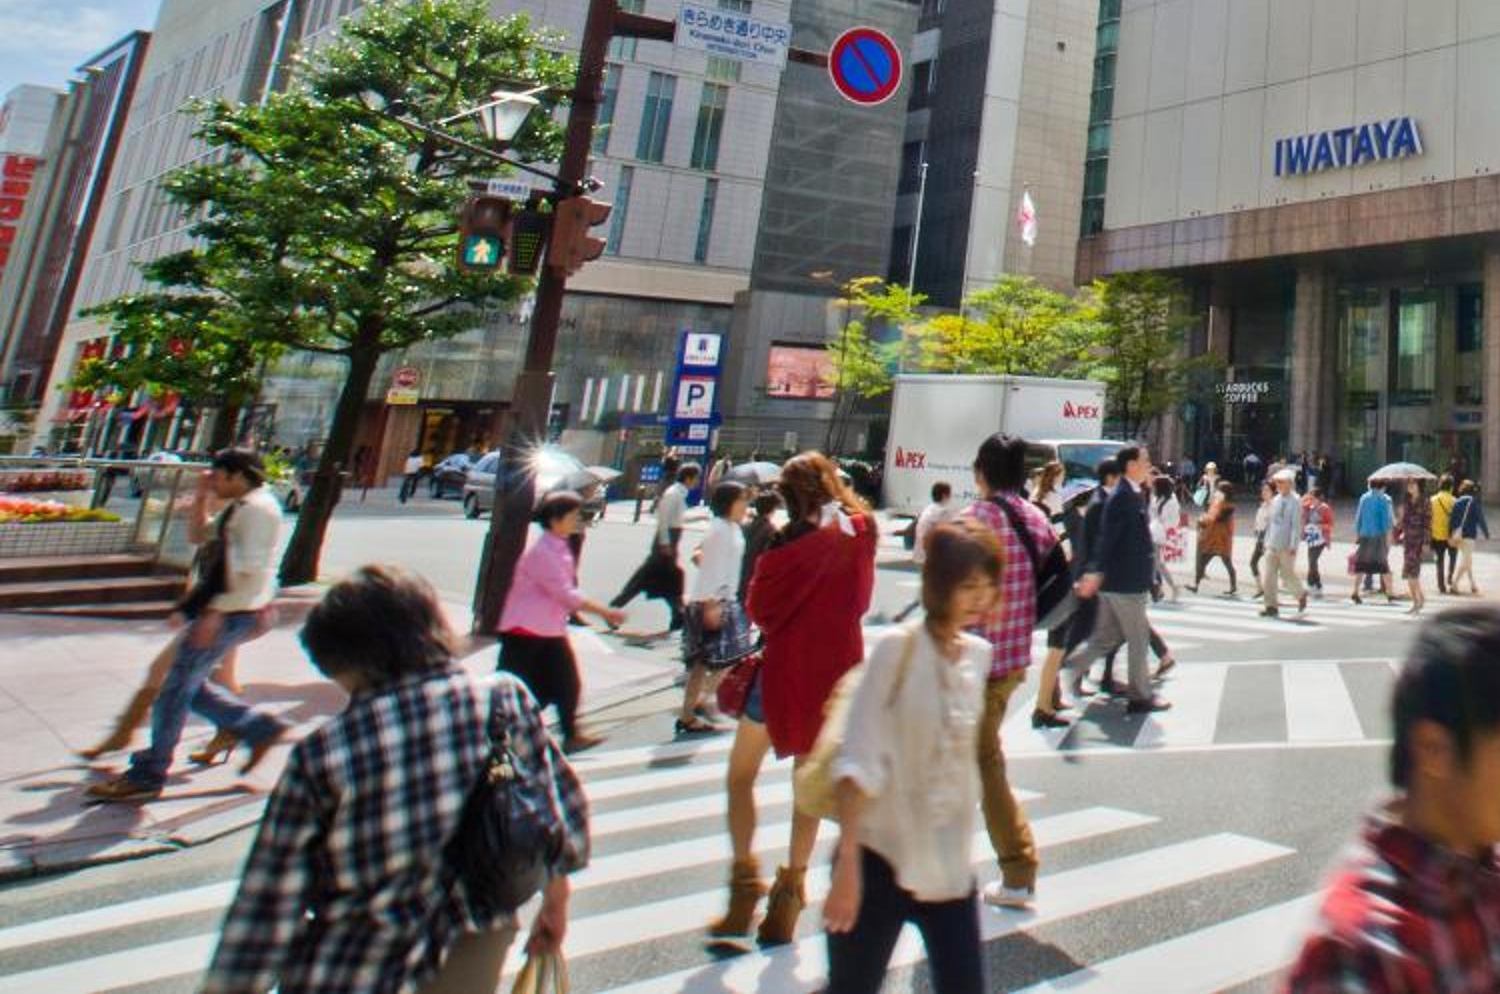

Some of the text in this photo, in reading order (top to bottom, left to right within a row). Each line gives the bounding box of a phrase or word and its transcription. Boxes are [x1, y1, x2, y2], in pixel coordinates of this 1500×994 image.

[683, 8, 787, 45] きらめき通り中央
[1274, 116, 1422, 177] IWATAYA
[687, 383, 705, 406] P
[1063, 401, 1099, 418] APEX
[895, 446, 926, 469] APEX
